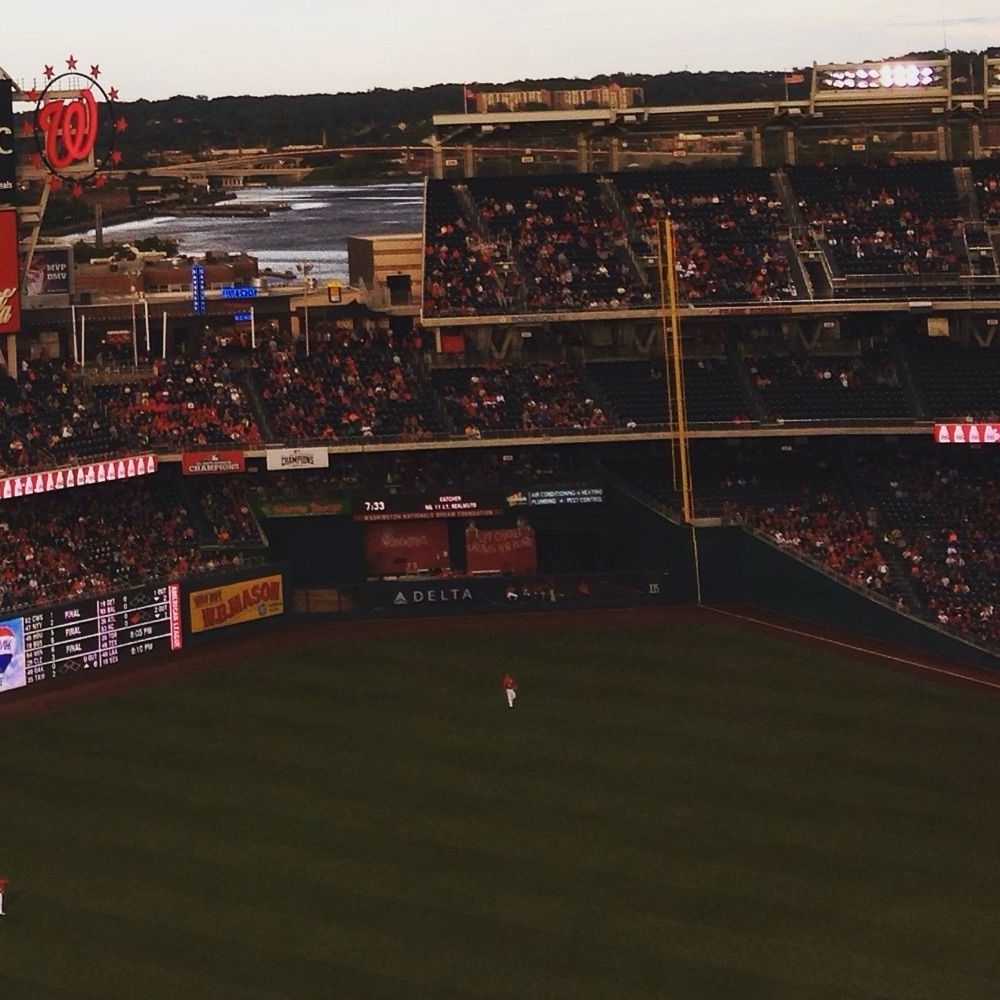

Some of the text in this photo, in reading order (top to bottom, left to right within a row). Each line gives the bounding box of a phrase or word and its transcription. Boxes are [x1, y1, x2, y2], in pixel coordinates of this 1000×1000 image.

[47, 264, 67, 272] MVP
[47, 272, 67, 280] DMV
[281, 456, 314, 466] CHAMPIONS
[189, 464, 239, 472] CHAMPIONS
[365, 502, 385, 510] 7:33
[414, 589, 473, 602] DELTA
